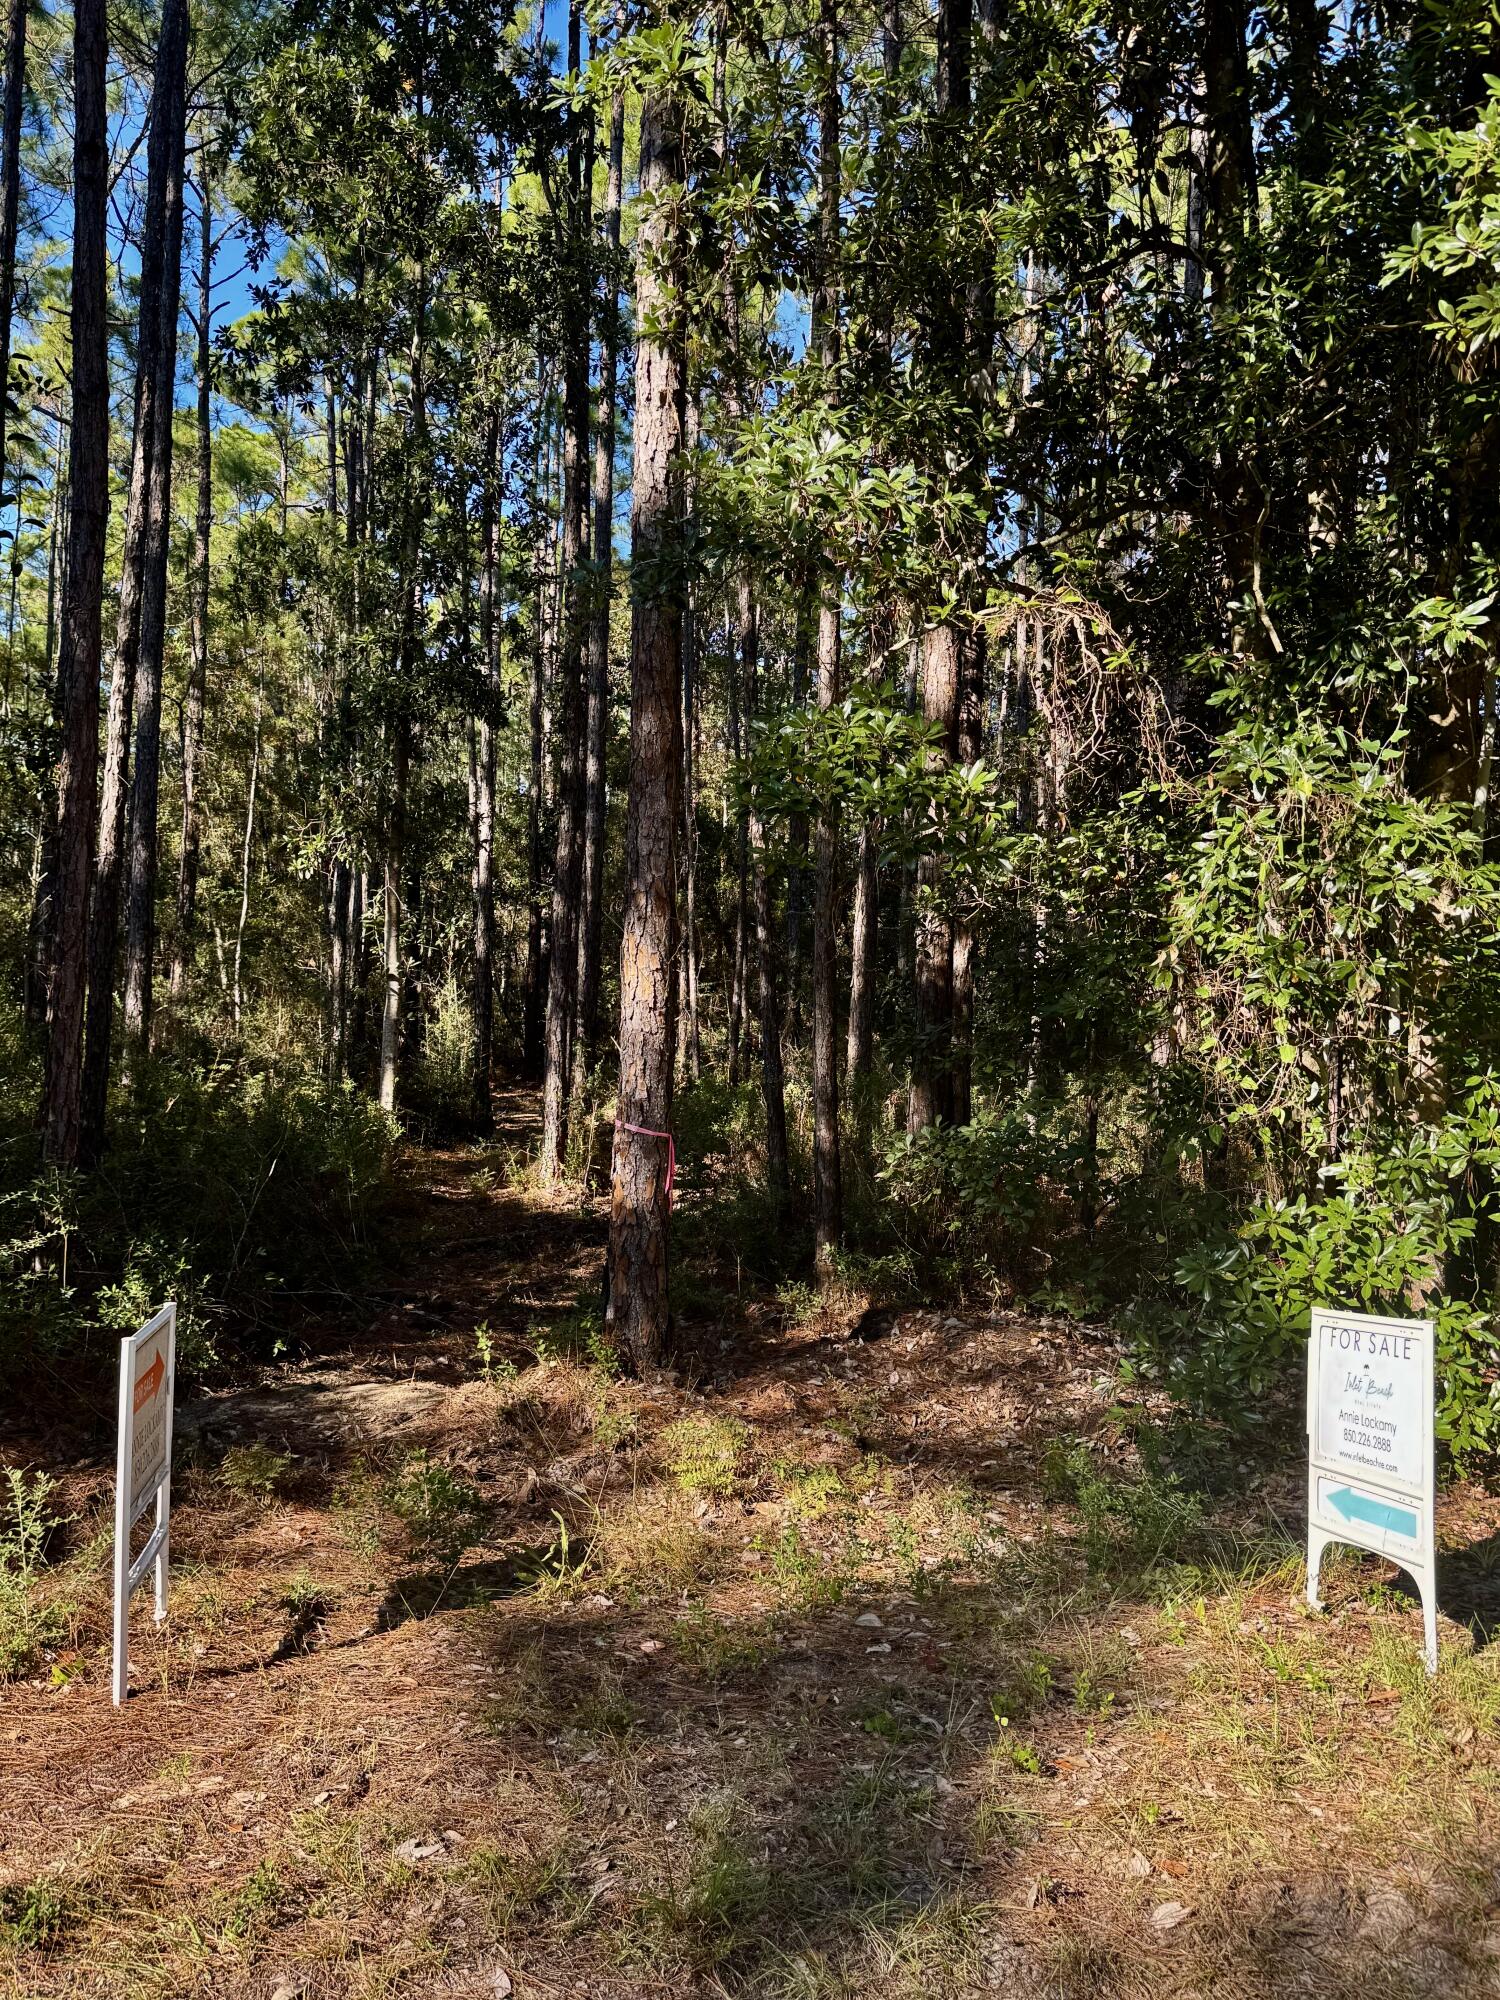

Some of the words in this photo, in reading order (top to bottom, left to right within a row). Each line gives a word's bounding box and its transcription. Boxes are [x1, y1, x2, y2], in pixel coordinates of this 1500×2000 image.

[1331, 1328, 1360, 1351] FOR
[1369, 1333, 1411, 1360] SALE
[1344, 1371, 1363, 1392] Inlet
[1366, 1378, 1394, 1399] Beach
[1339, 1408, 1359, 1425] Annie
[1361, 1414, 1397, 1437] Lockamy
[1344, 1428, 1392, 1453] 850.226.2888
